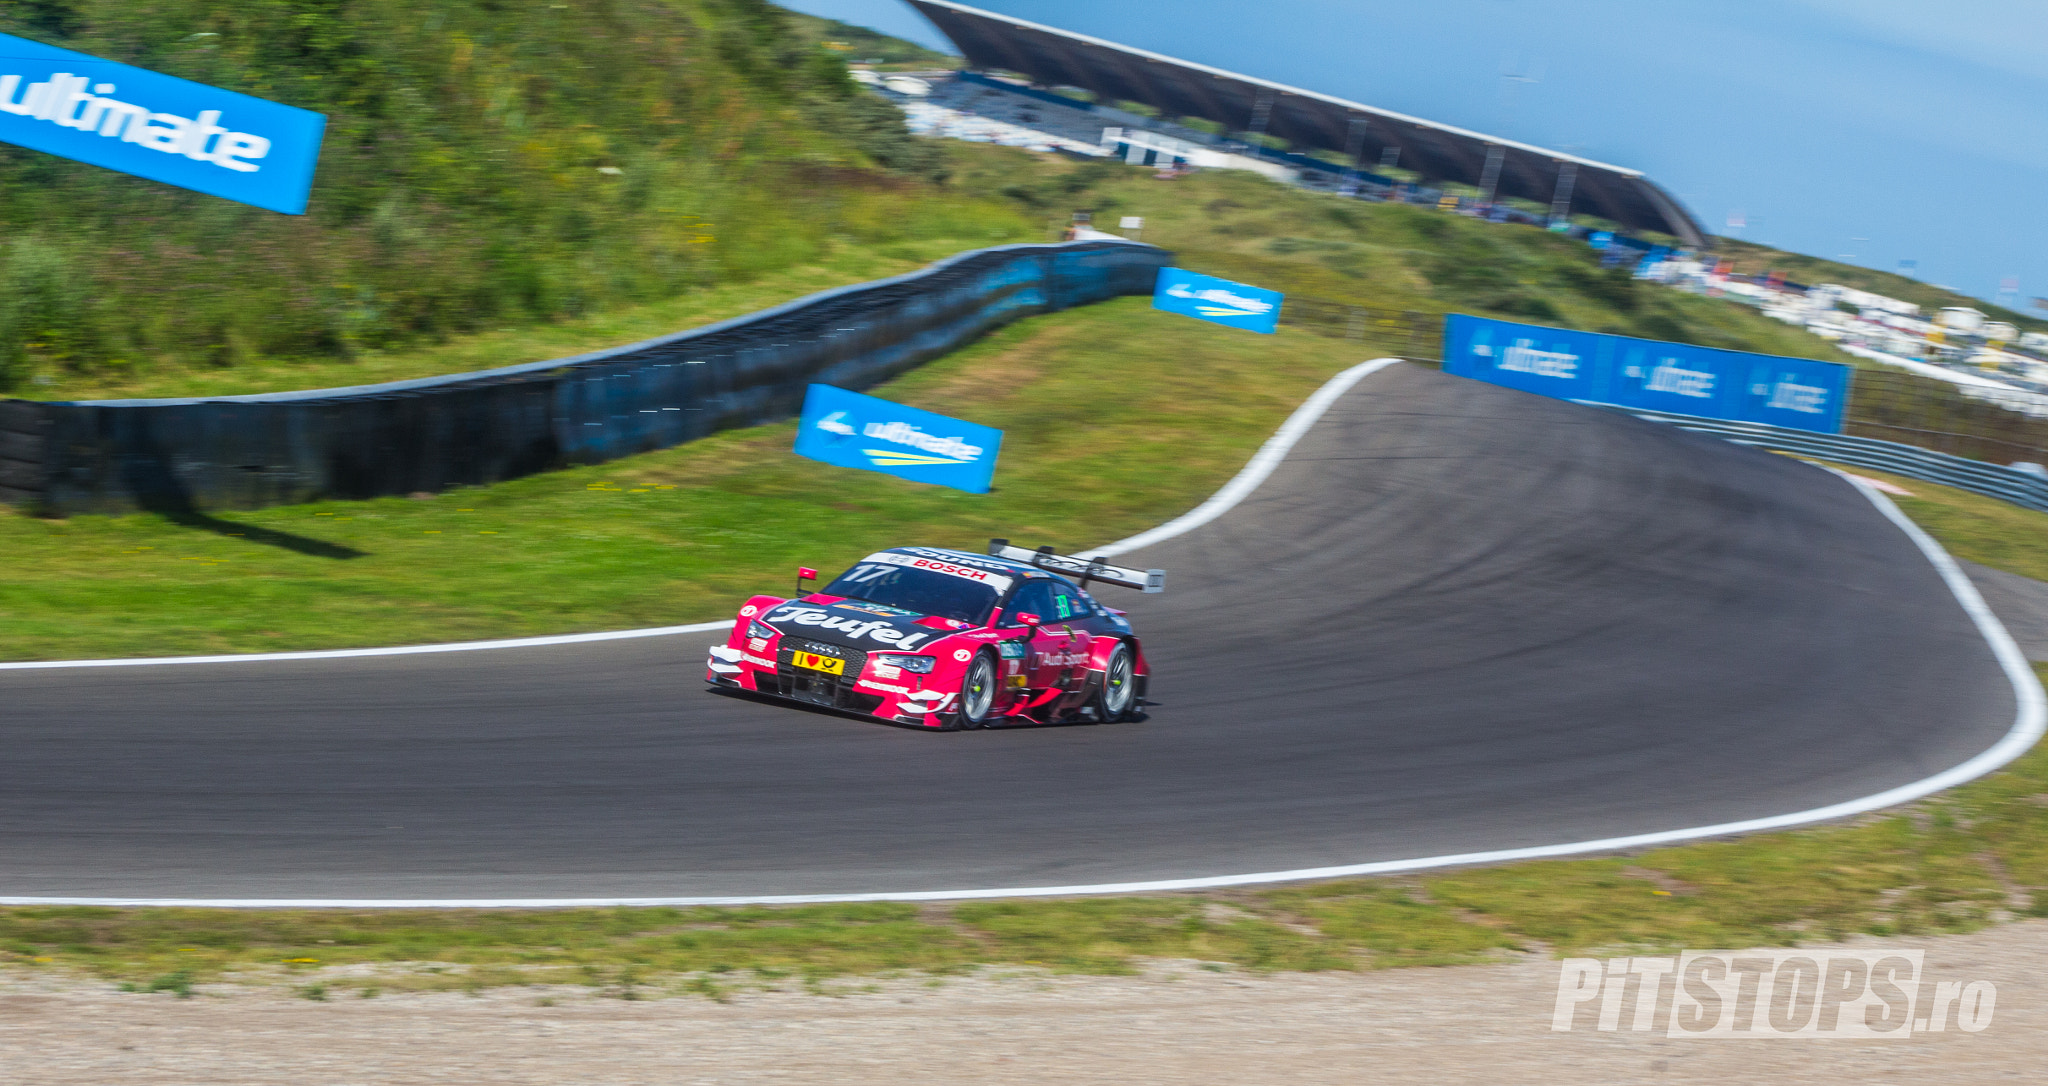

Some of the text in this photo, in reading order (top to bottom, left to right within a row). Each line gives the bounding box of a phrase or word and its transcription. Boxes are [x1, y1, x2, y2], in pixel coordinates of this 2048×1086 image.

[0, 73, 272, 173] ultimate
[842, 564, 901, 583] 17
[913, 559, 989, 581] BOSCH
[767, 606, 929, 651] Teufel
